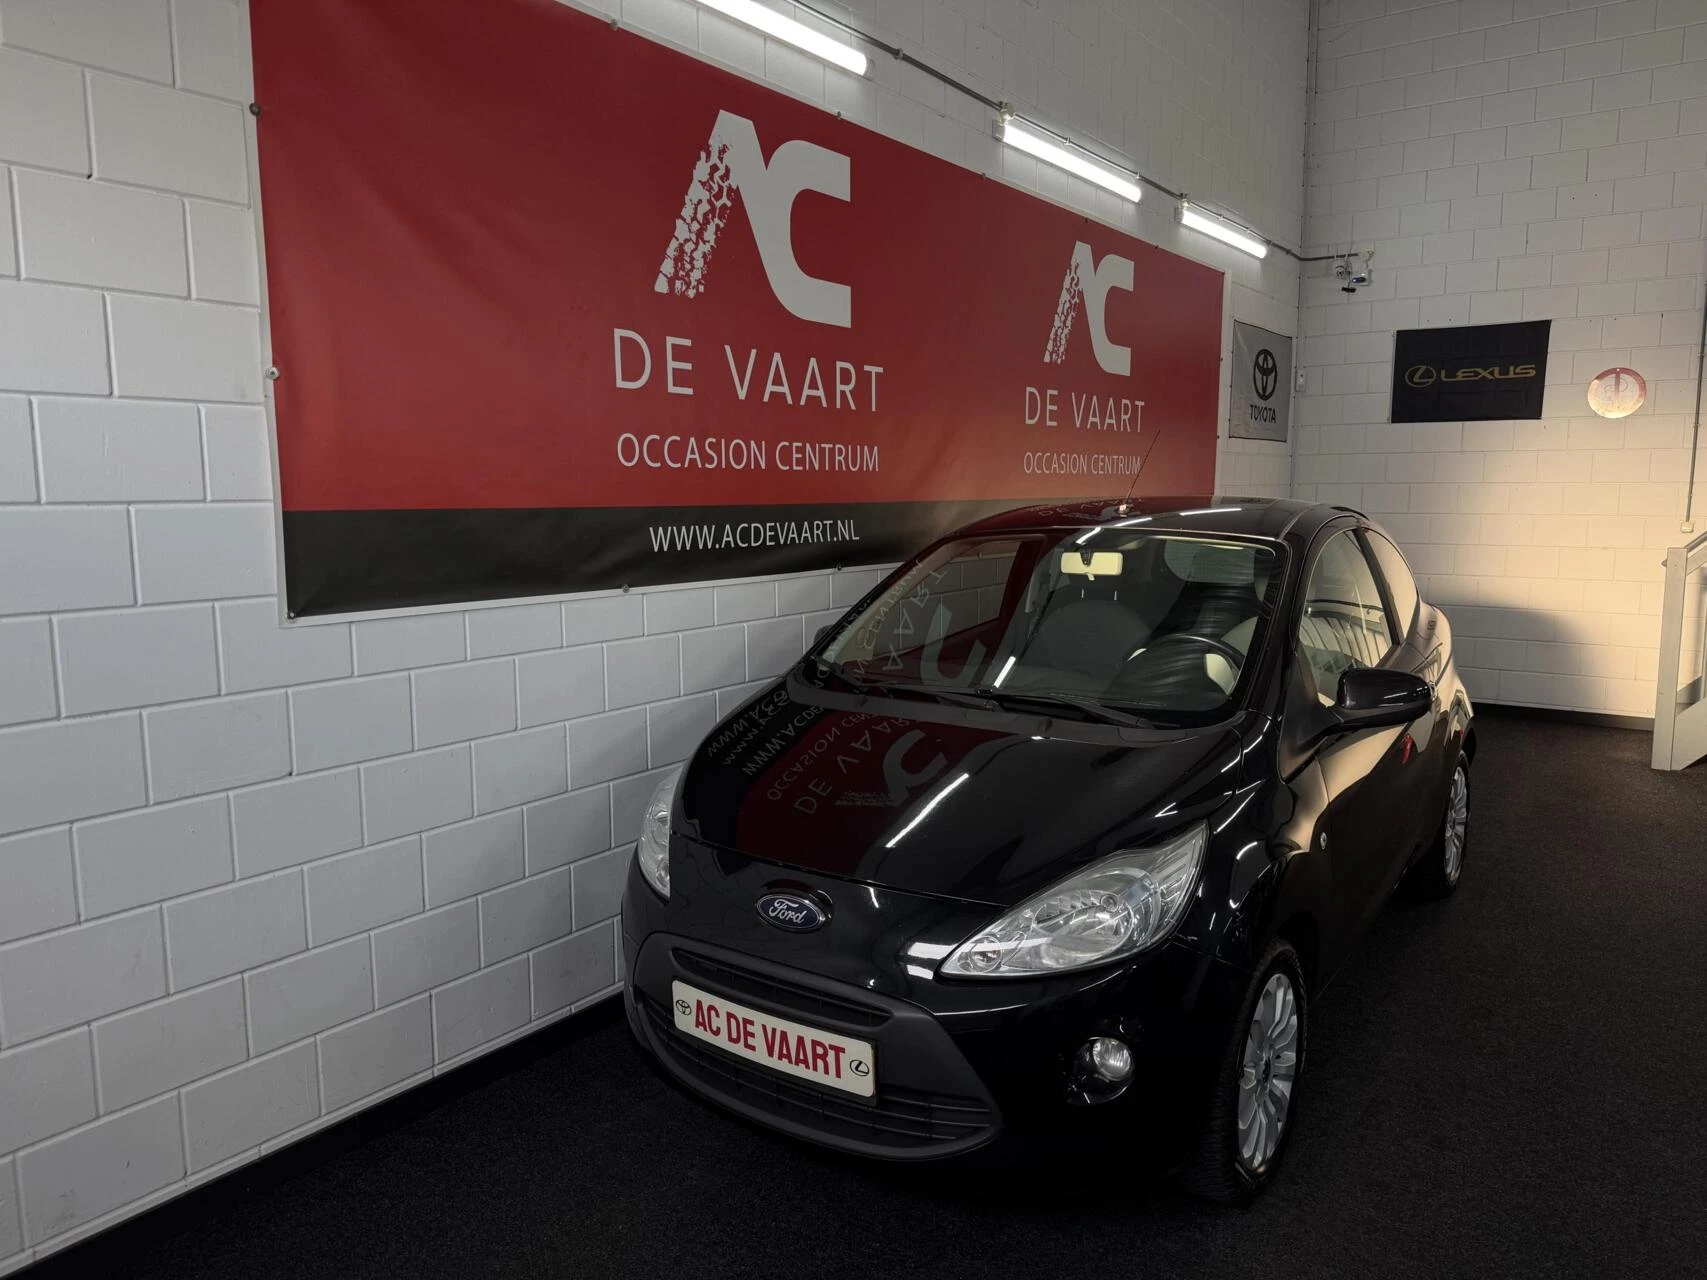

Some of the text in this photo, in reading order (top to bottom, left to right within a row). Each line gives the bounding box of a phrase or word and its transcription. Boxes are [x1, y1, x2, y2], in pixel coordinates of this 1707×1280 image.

[654, 109, 851, 328] AC
[613, 327, 884, 412] DE VAART
[1440, 364, 1537, 382] LEXUS
[1025, 386, 1145, 433] DE VAART
[1250, 404, 1277, 423] TOYOTA
[617, 432, 879, 472] OCCASION CENTRUM
[1023, 452, 1141, 475] OCCASION CENTRUM
[649, 519, 860, 552] WWW.ACDEVAART.NL
[768, 898, 808, 925] Ford
[695, 999, 846, 1079] AC DE VAART
